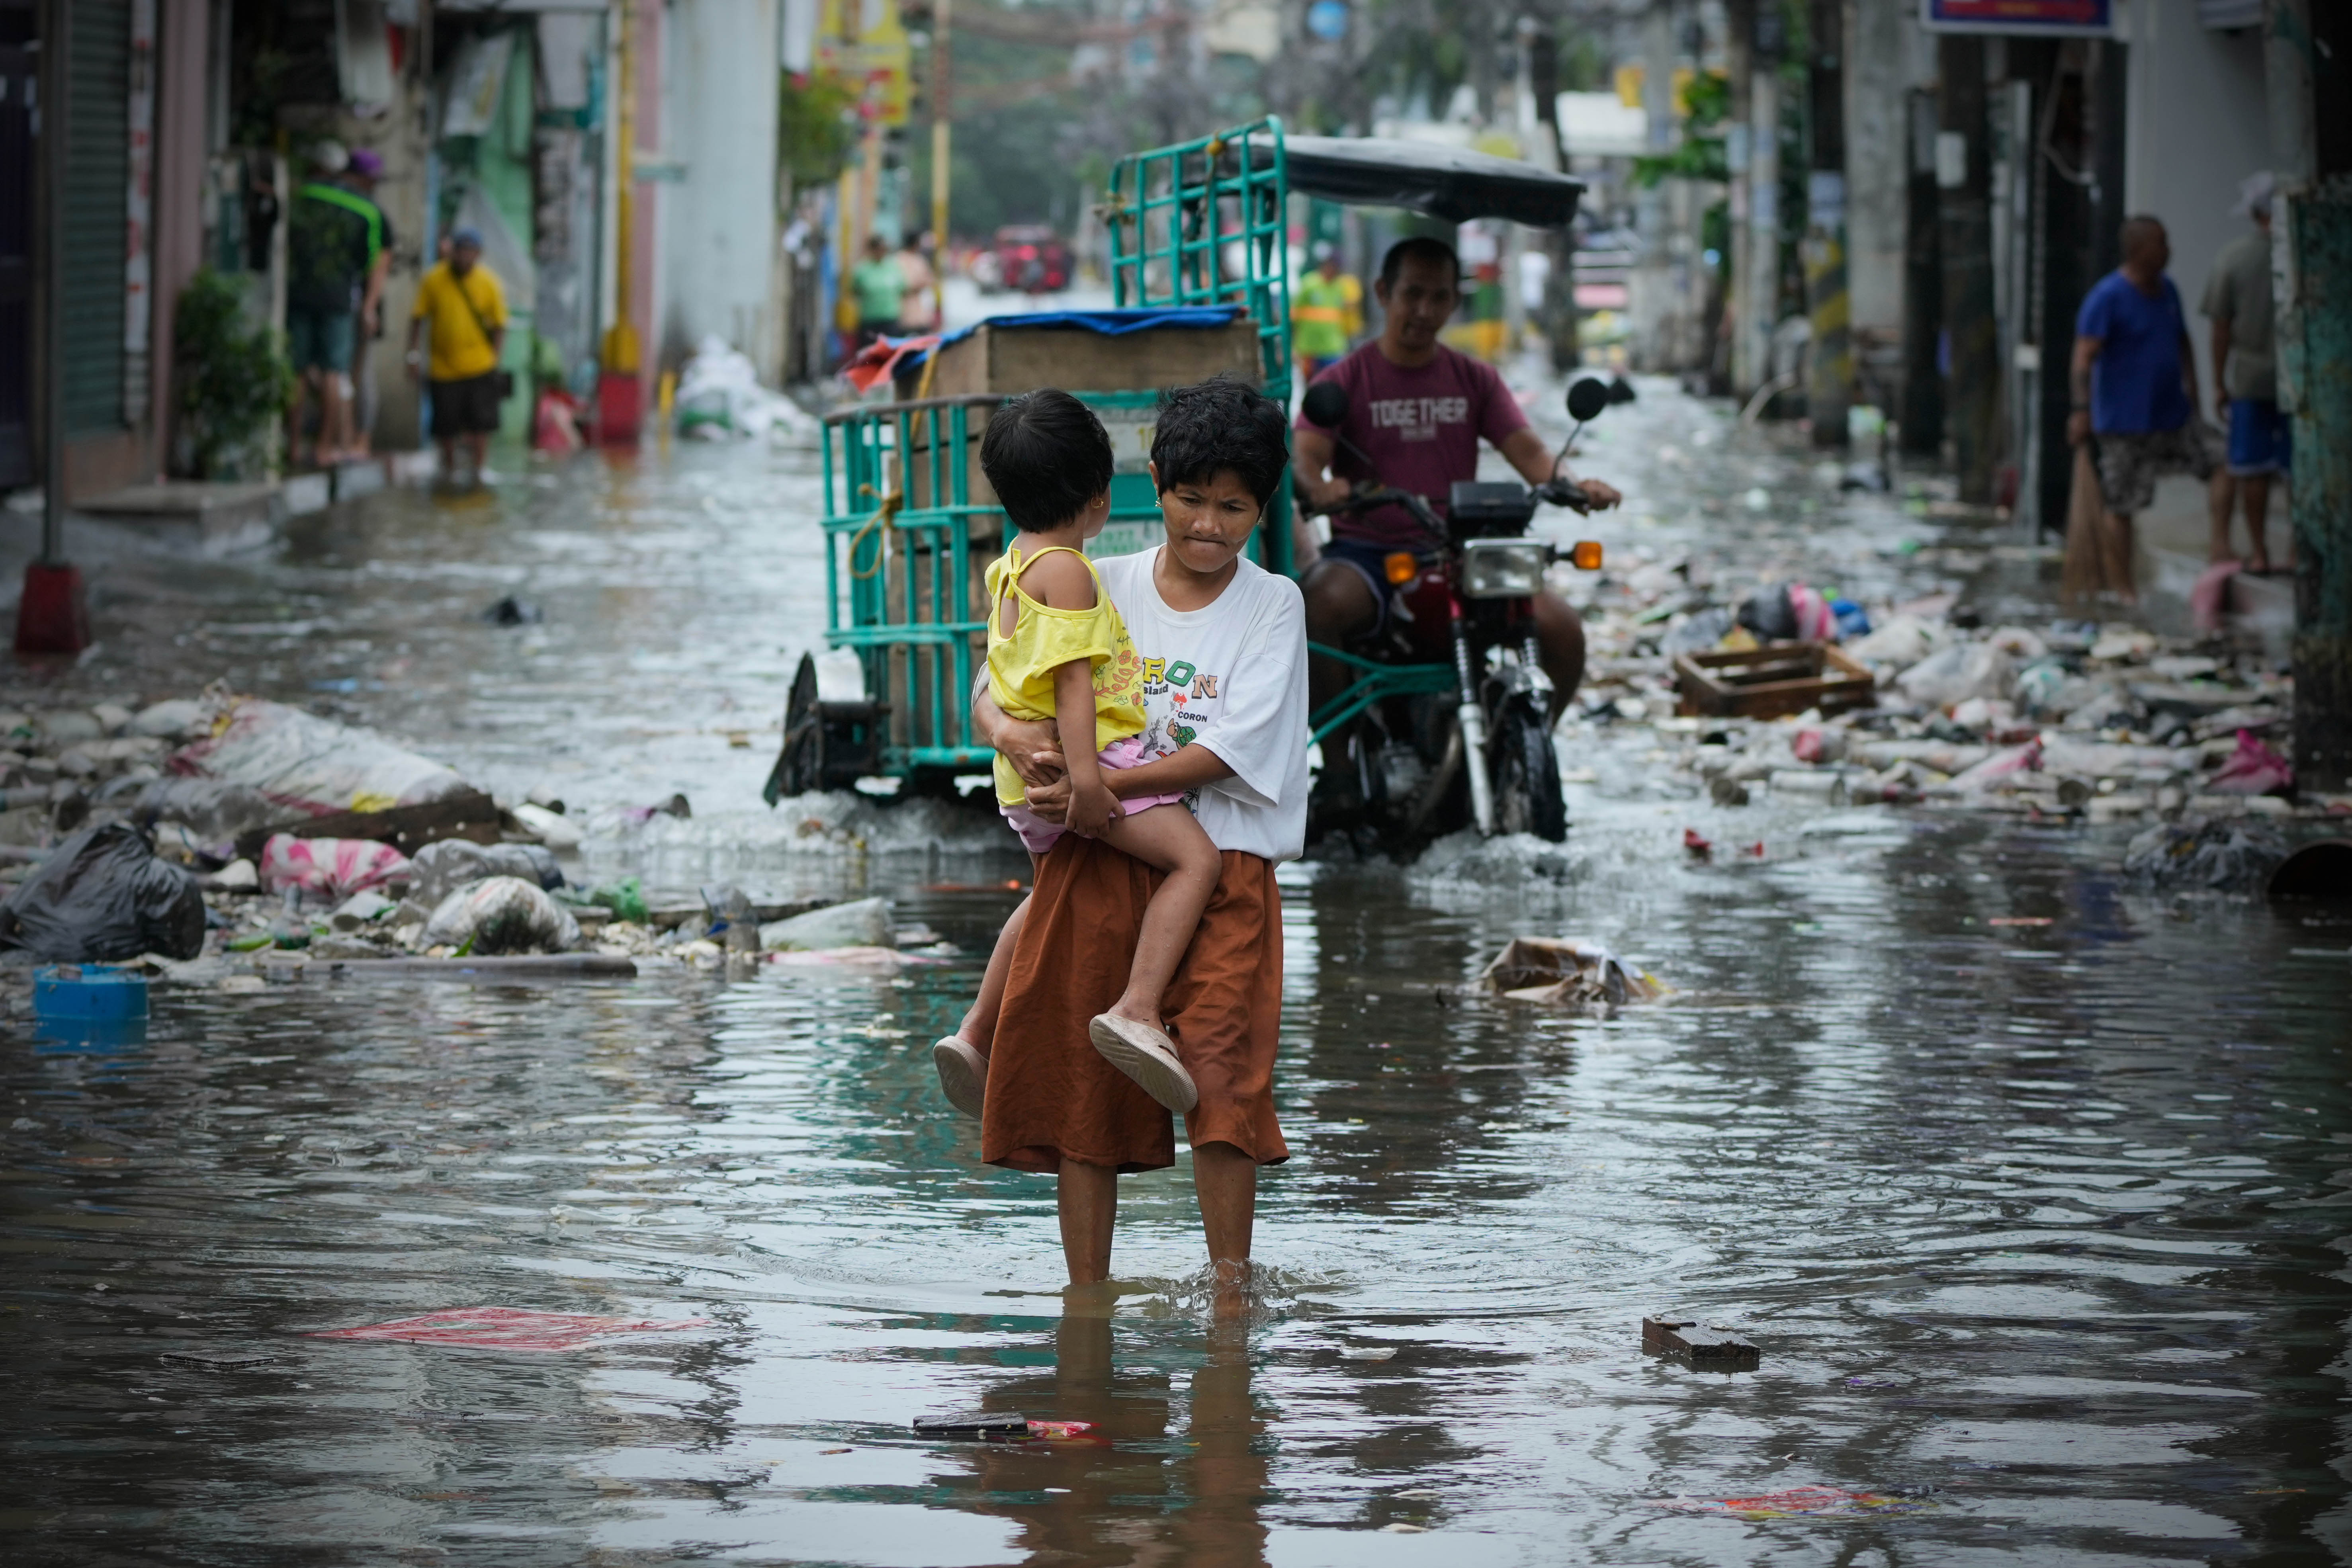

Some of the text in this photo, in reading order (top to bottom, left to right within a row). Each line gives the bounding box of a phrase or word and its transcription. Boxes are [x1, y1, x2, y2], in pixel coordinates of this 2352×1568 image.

[1369, 397, 1468, 427] TOGETHER
[1143, 657, 1217, 699] RON
[1144, 684, 1169, 695] sland
[1178, 711, 1208, 722] CORON
